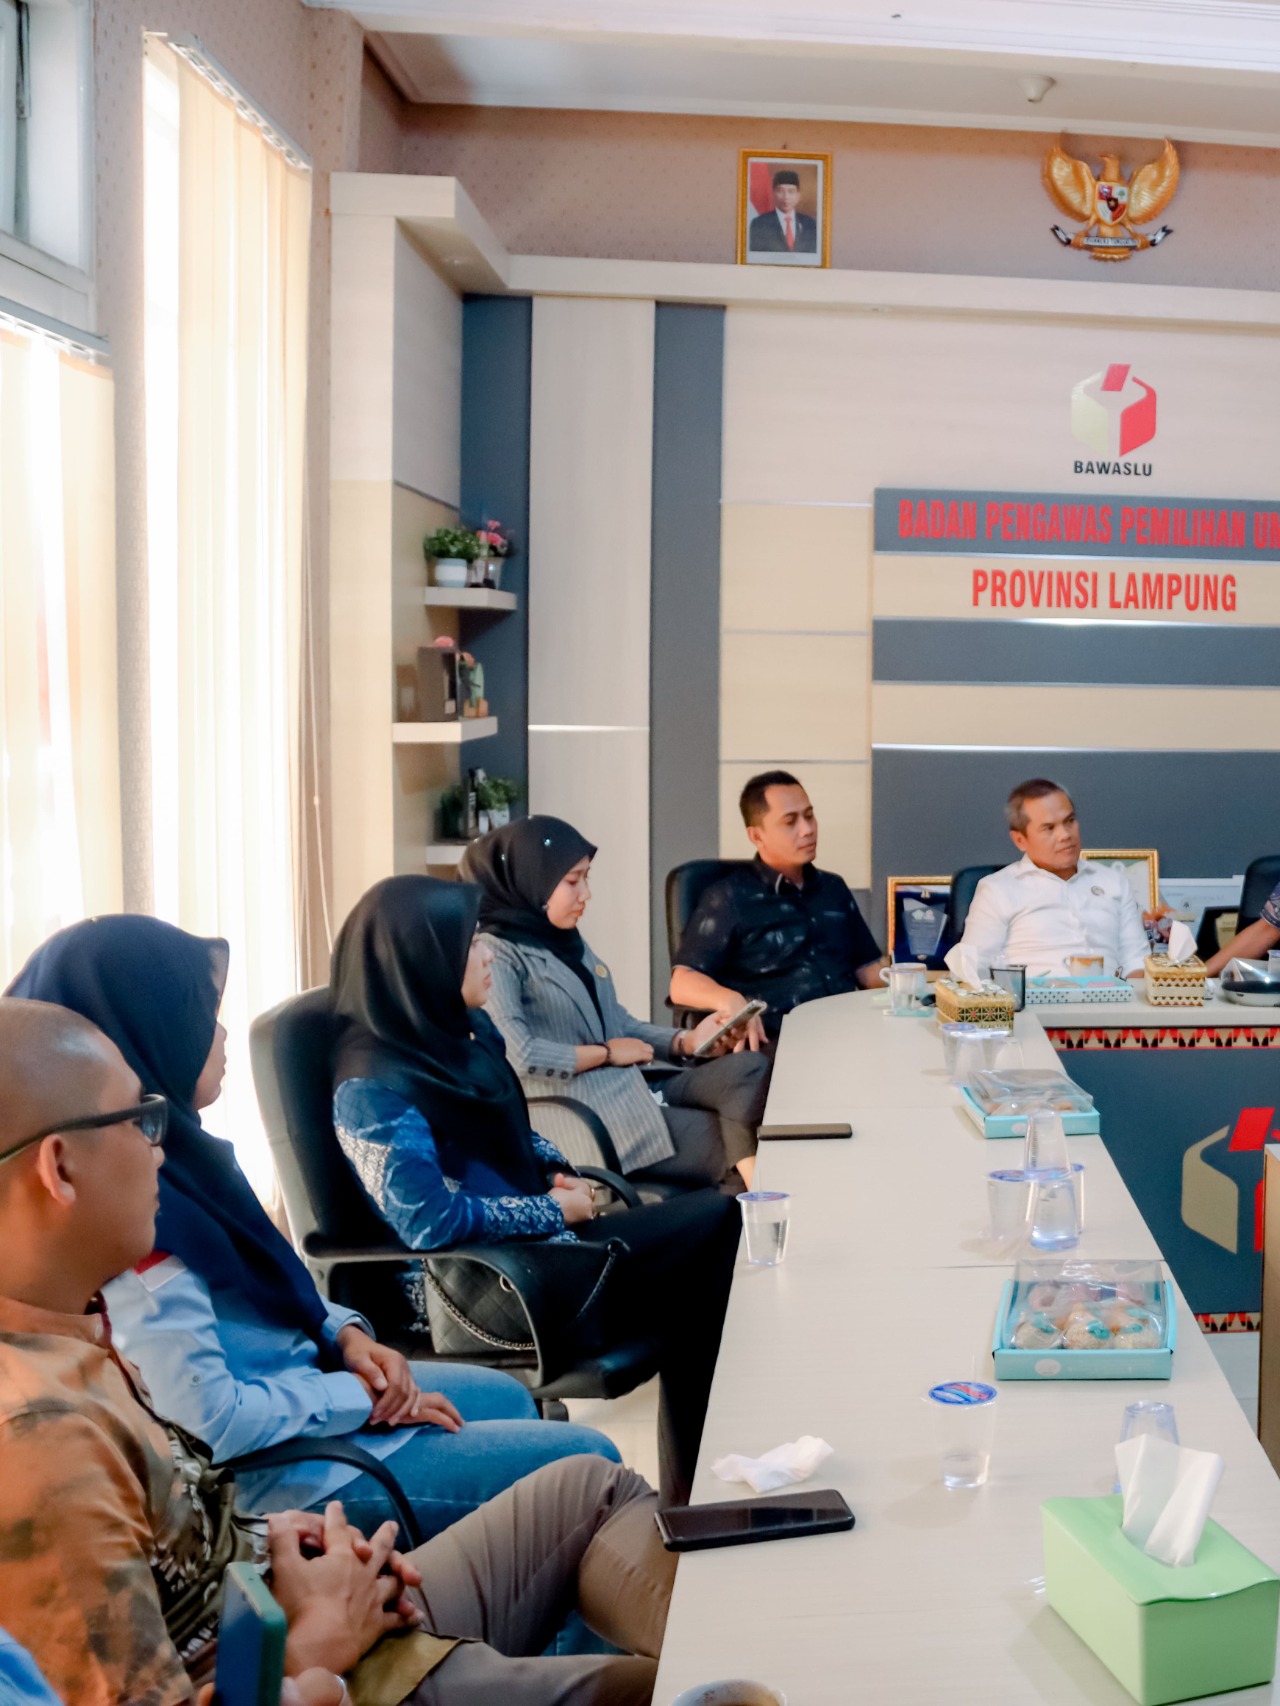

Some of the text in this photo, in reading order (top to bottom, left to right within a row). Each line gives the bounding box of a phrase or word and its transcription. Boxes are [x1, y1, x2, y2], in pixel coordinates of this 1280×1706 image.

[1073, 460, 1152, 476] BAWASLU
[899, 499, 977, 540] BADAN
[986, 502, 1113, 544] PENGAWAS
[1120, 506, 1246, 548] PEMILIHAN
[972, 569, 1236, 611] PROVINSI LAMPUNG
